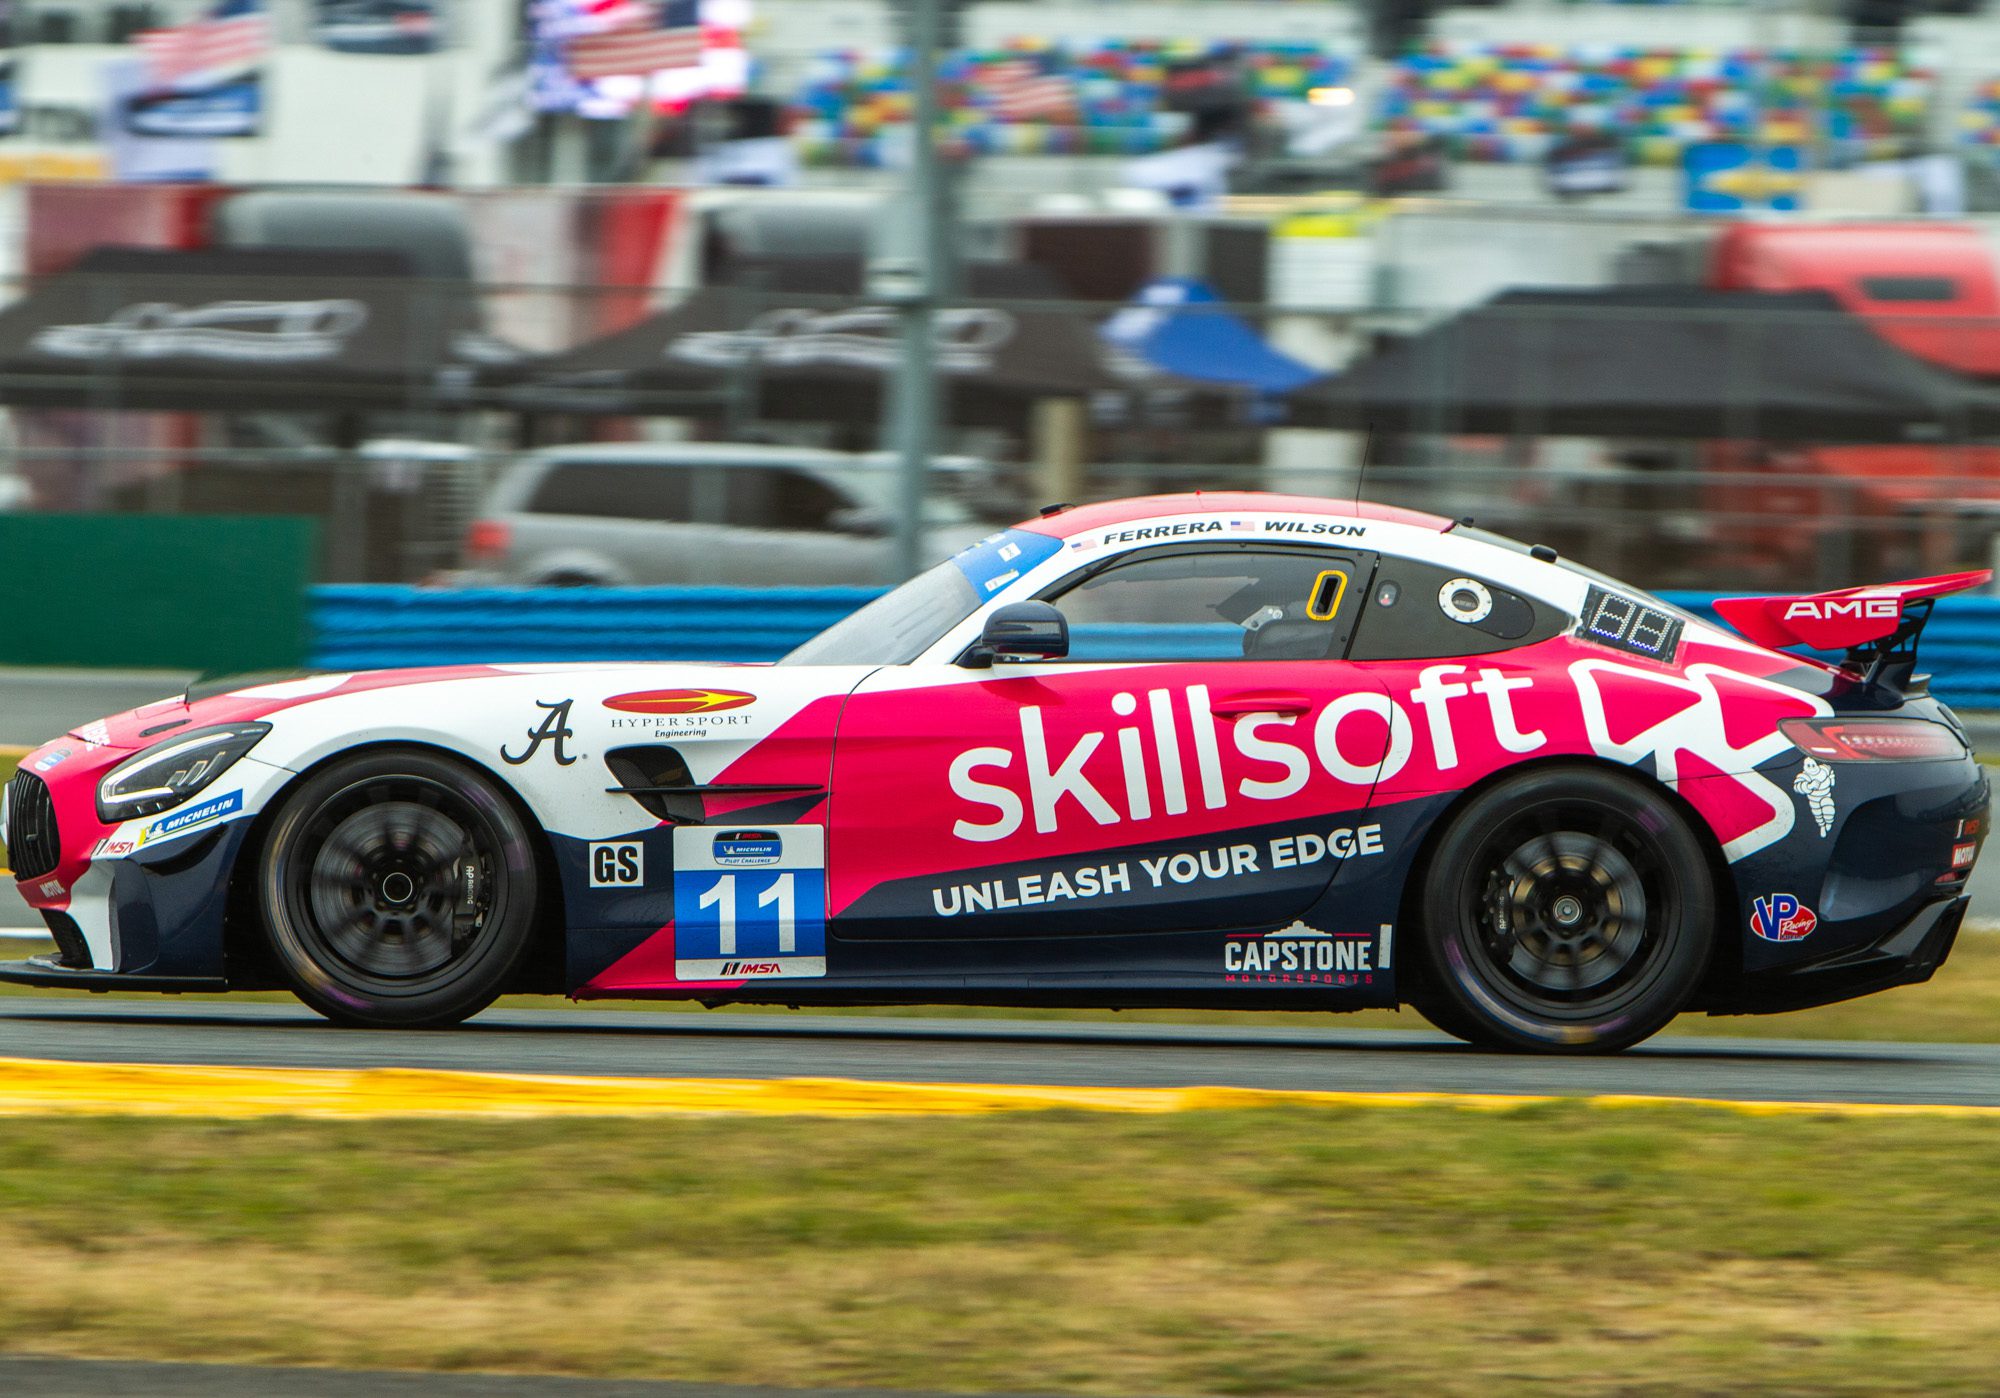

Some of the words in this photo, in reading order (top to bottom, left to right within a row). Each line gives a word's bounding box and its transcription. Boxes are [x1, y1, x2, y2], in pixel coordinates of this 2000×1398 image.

[1103, 520, 1223, 545] FERRERA
[1264, 520, 1367, 537] WILSON
[1783, 599, 1898, 620] AMG
[500, 698, 577, 766] A
[610, 716, 679, 728] HYPER
[685, 715, 752, 726] SPORT
[654, 728, 707, 738] Engineering
[947, 664, 1547, 843] skillsoft
[166, 798, 234, 831] MICHELIN
[103, 841, 135, 854] IMSA
[466, 865, 475, 879] AP
[593, 845, 639, 884] GS
[932, 862, 1131, 917] UNLEASH
[1138, 843, 1260, 888] YOUR
[1269, 823, 1385, 870] EDGE
[699, 872, 796, 955] 11
[1753, 893, 1800, 941] VP
[1781, 918, 1816, 935] Racing
[740, 963, 782, 974] IMSA
[1225, 941, 1373, 972] CAPSTONE
[1225, 974, 1373, 984] MOTORSPORTS
